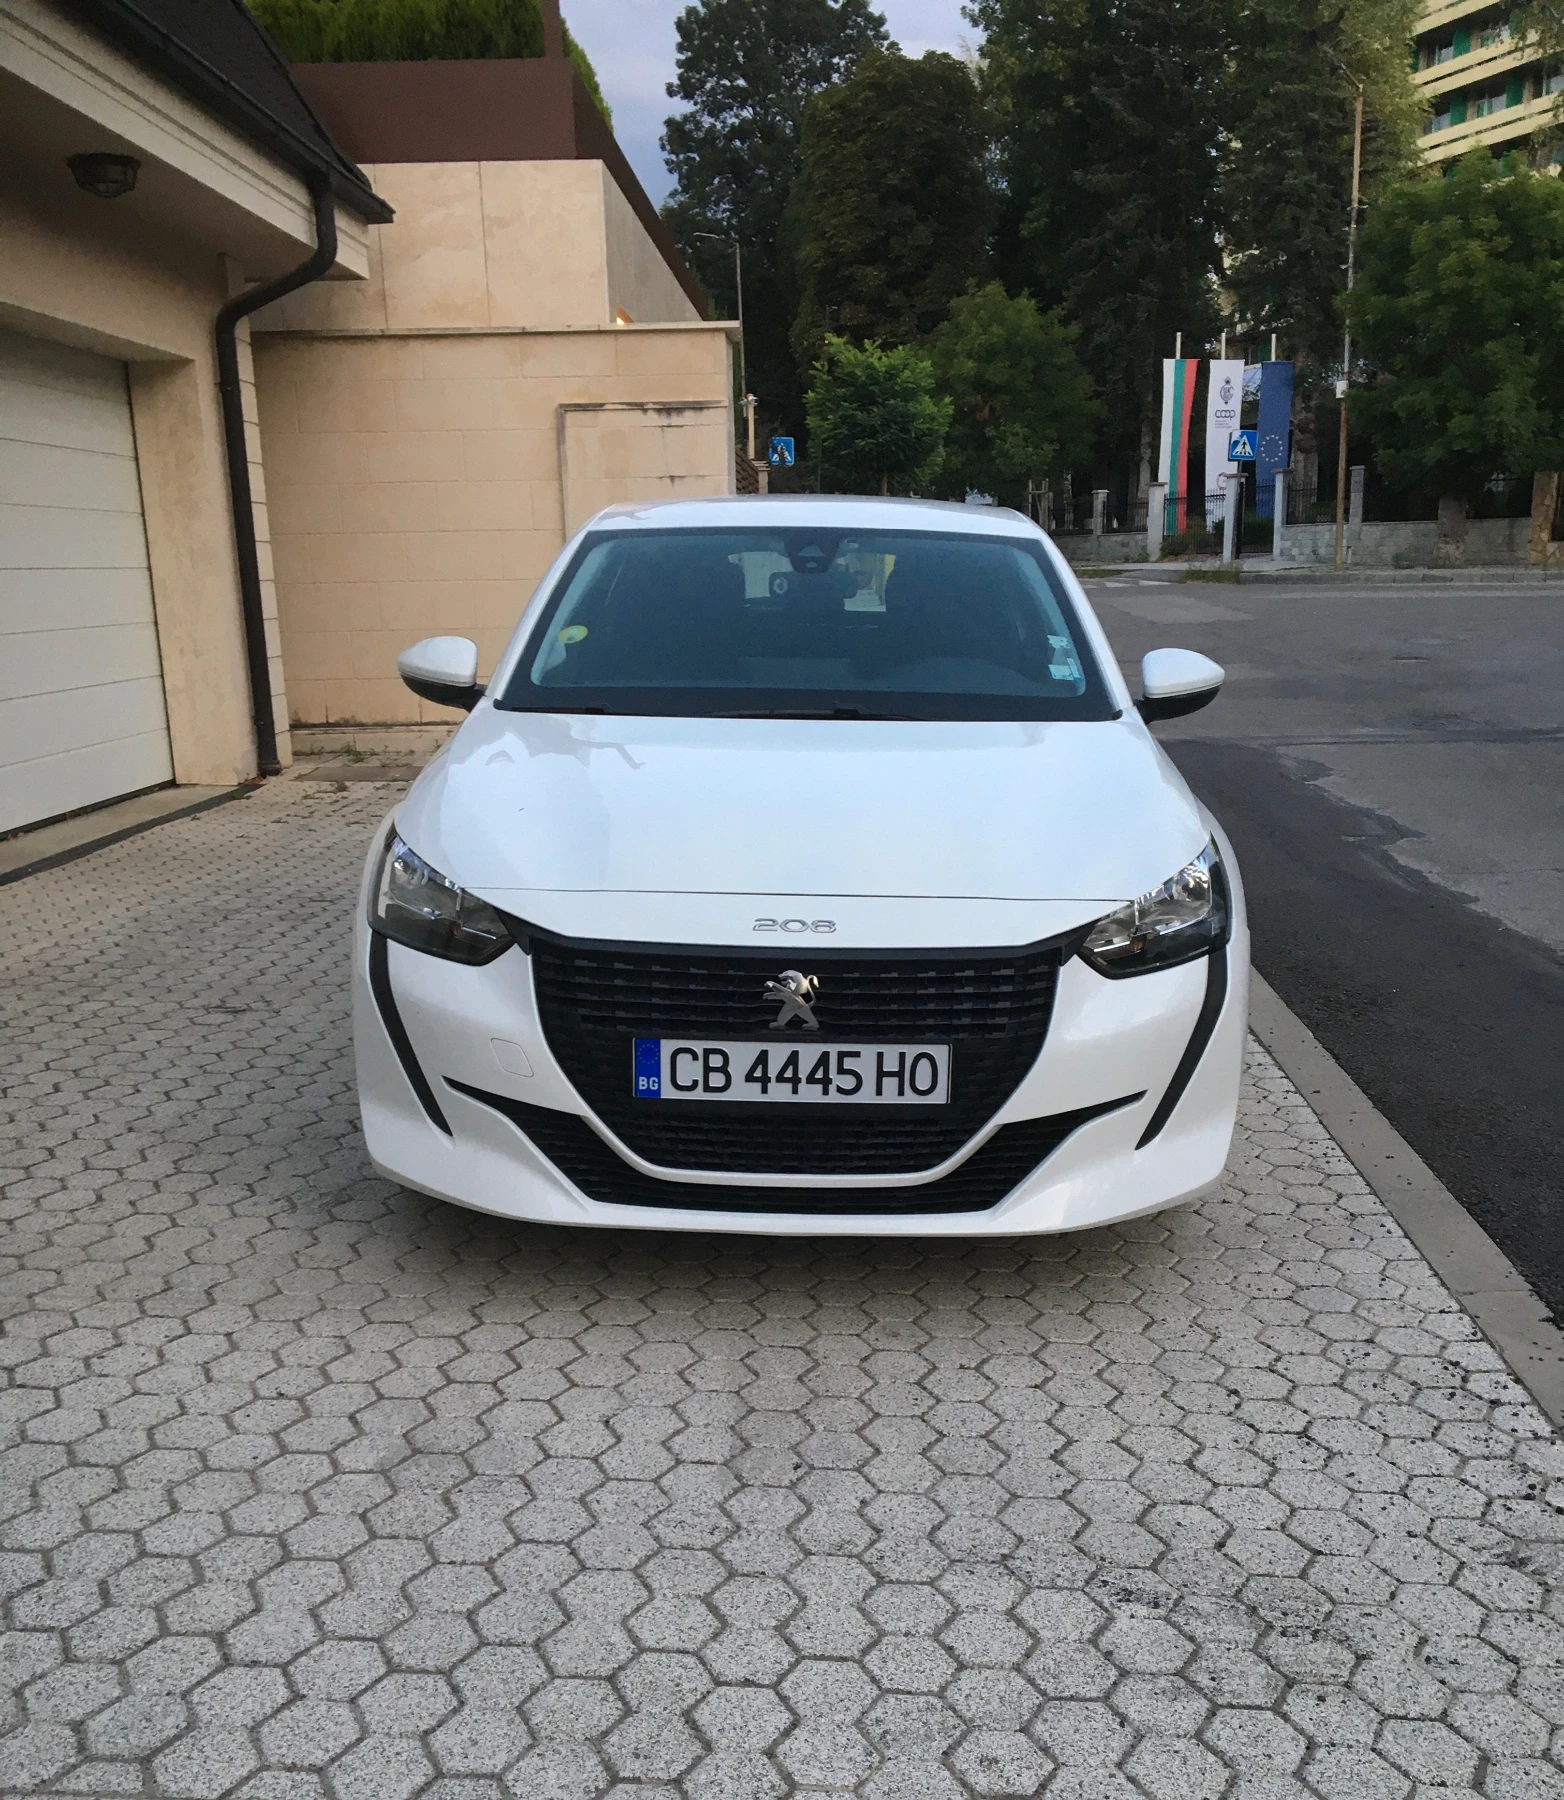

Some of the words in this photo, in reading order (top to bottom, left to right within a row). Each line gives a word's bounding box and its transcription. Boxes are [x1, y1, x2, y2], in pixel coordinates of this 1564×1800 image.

[1215, 409, 1236, 421] coop
[752, 918, 837, 933] 208
[670, 1046, 732, 1094] CB
[744, 1049, 863, 1096] 4445
[875, 1051, 939, 1098] HO
[638, 1076, 659, 1091] BG
